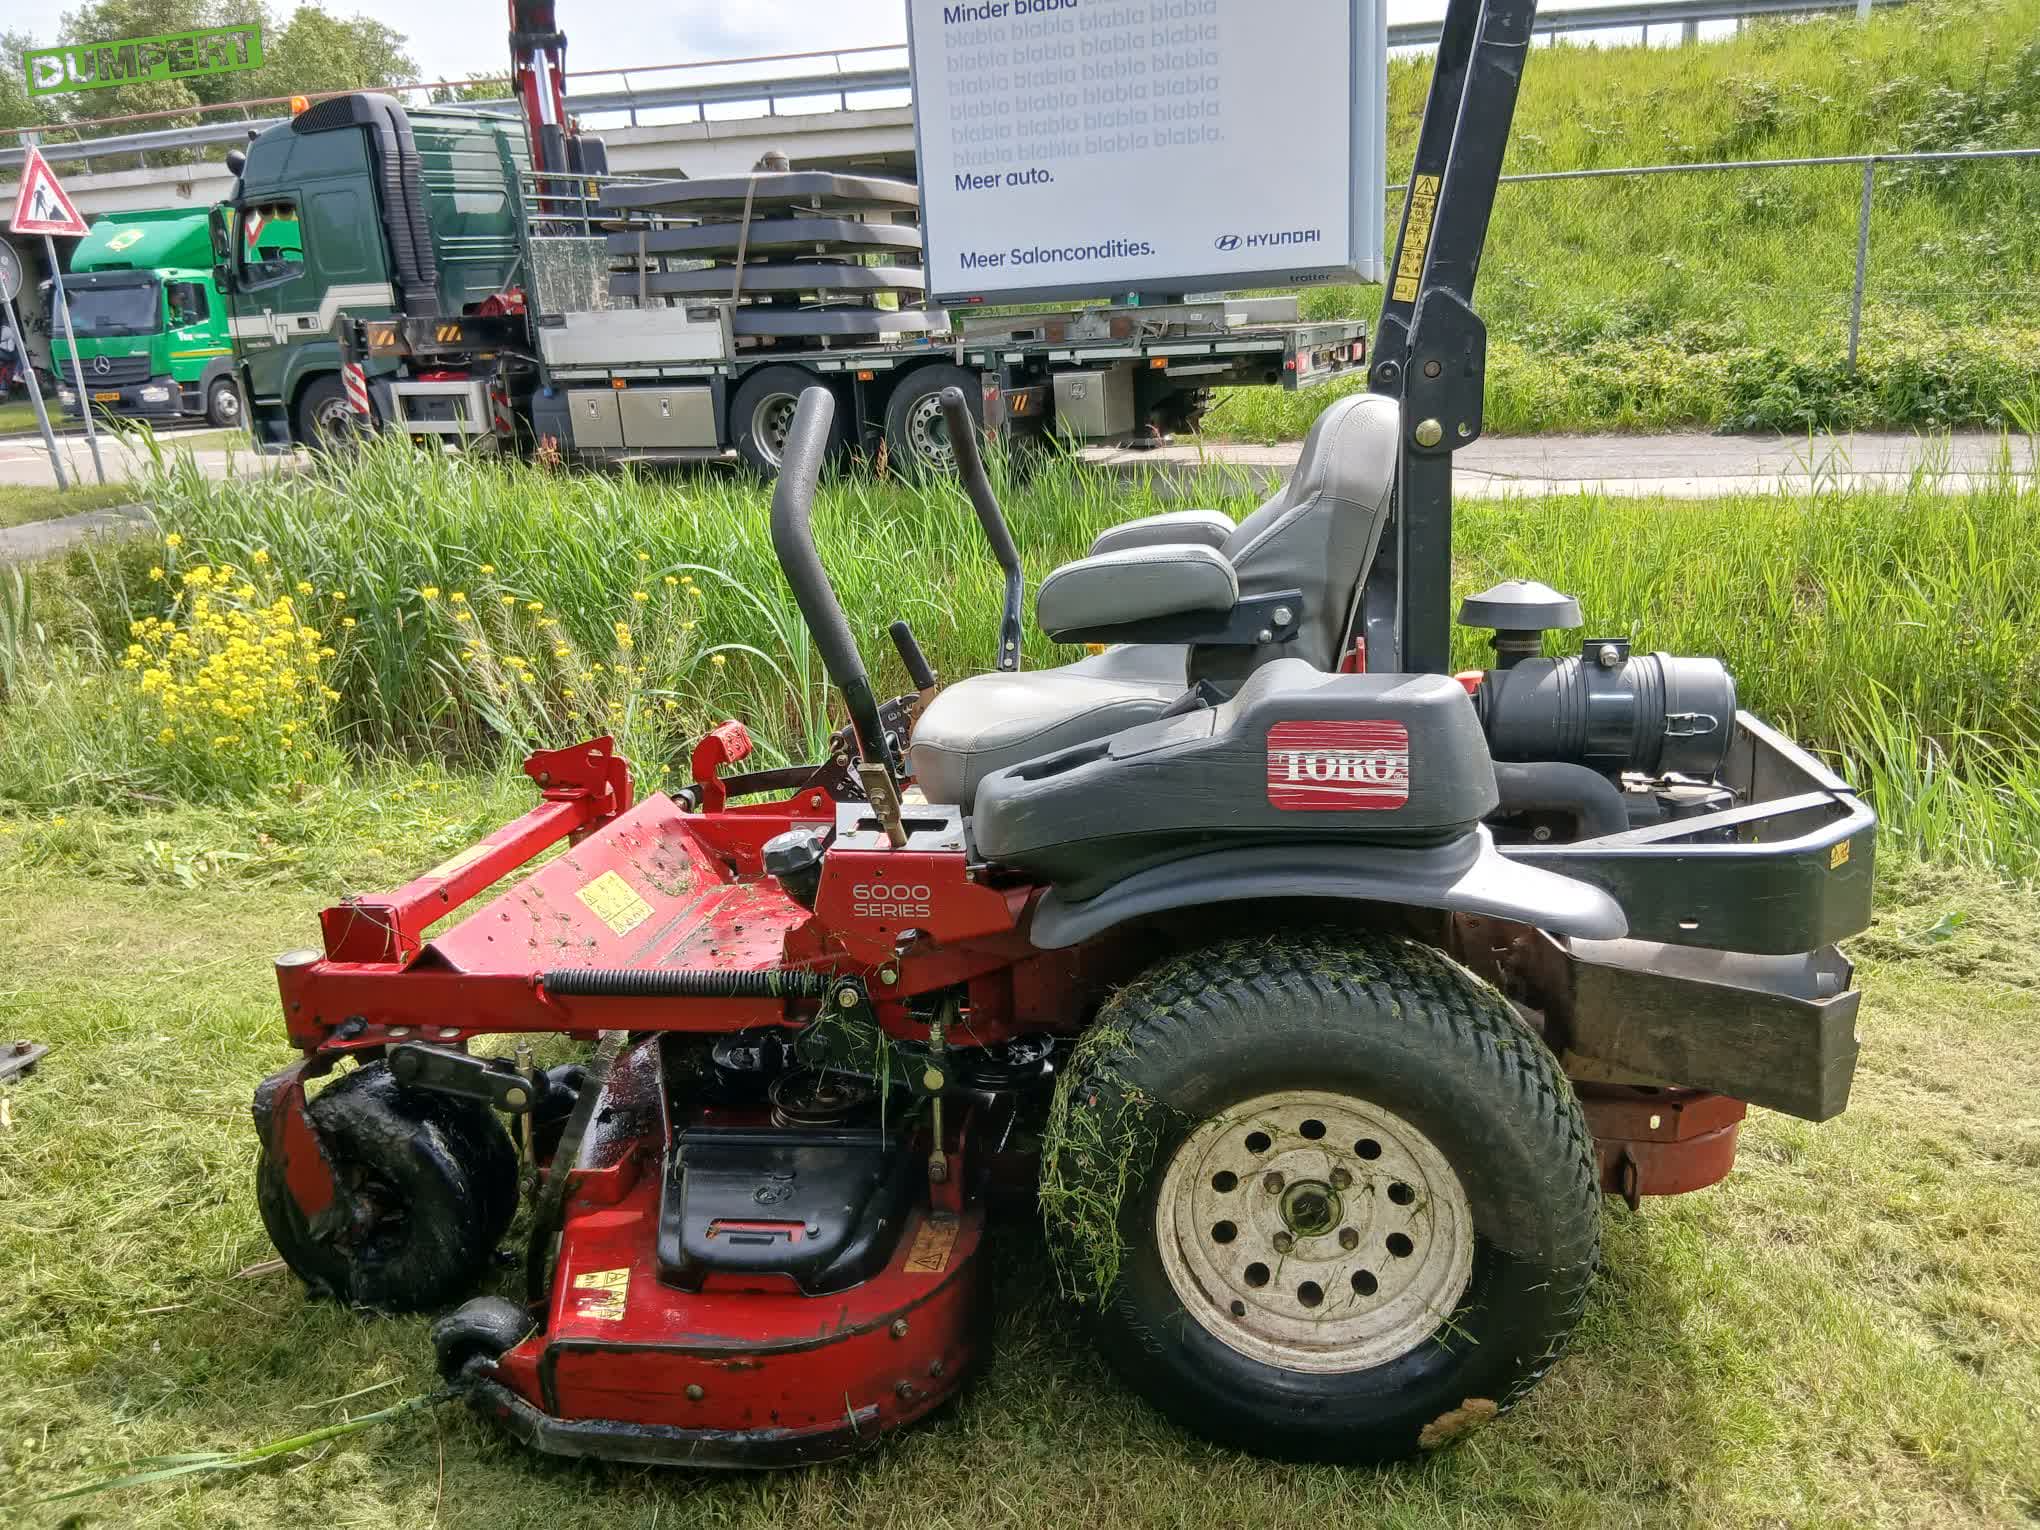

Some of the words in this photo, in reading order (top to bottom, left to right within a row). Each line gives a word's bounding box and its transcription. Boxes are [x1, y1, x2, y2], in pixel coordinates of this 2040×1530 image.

[944, 2, 1010, 24] Minder
[955, 173, 1001, 191] Meer
[1006, 168, 1054, 186] auto.
[1247, 229, 1321, 247] HYUNDAI
[960, 252, 1006, 269] Meer
[1010, 239, 1156, 265] Saloncondities.
[853, 884, 931, 901] 6000
[853, 903, 931, 918] SERIES
